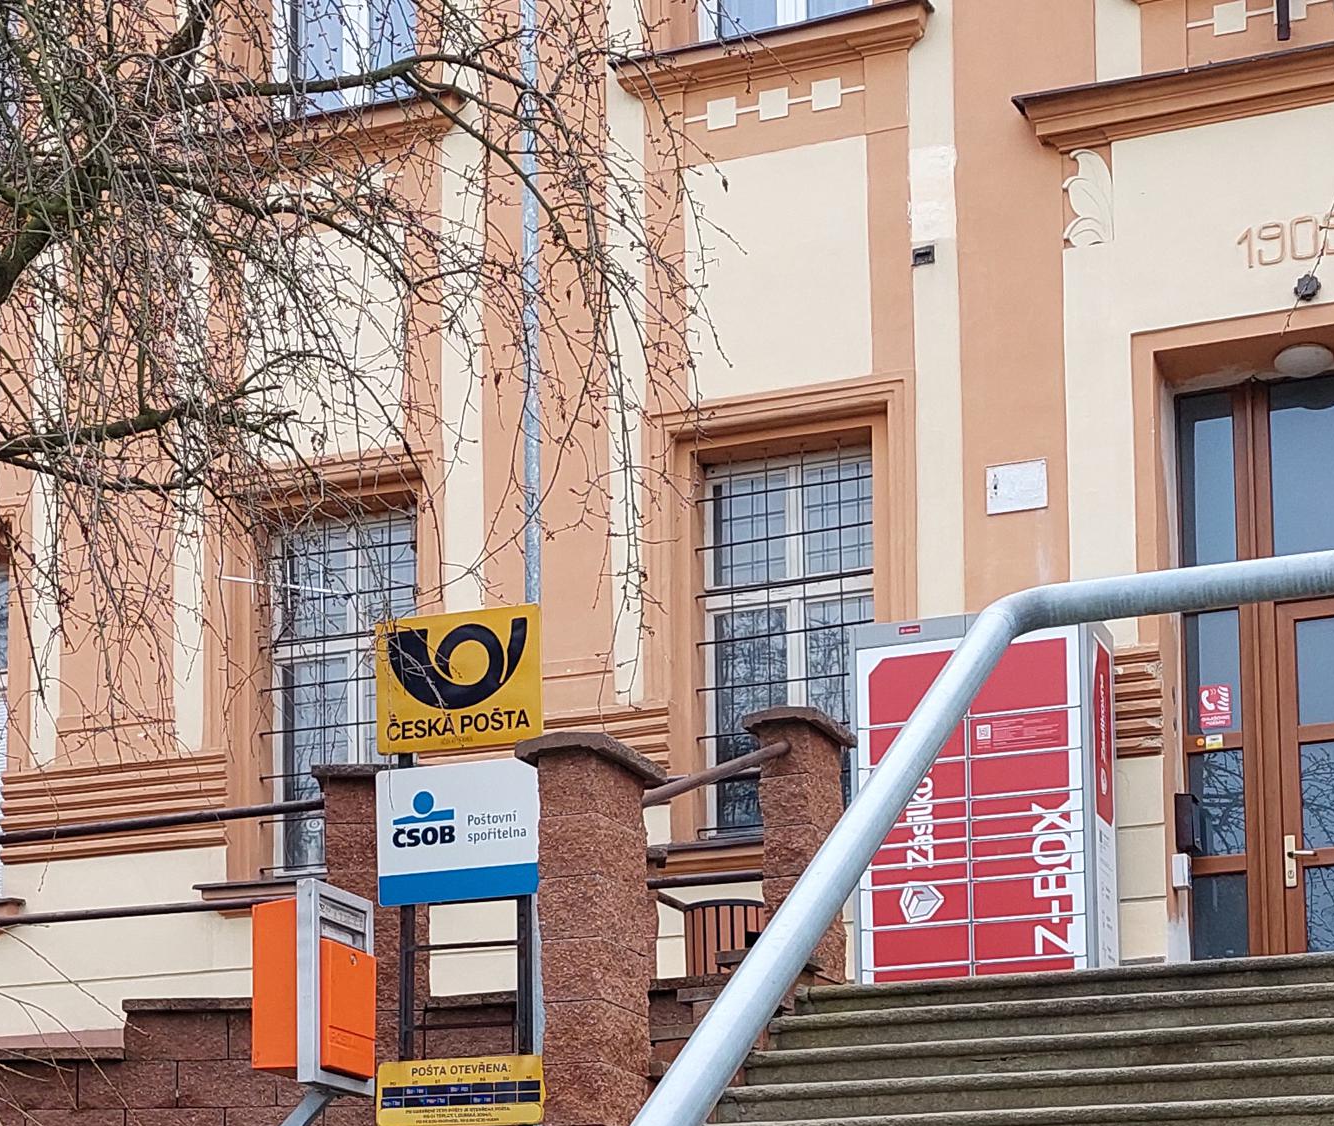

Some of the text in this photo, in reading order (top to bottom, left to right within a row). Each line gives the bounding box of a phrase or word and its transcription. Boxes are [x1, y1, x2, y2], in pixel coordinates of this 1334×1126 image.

[387, 708, 531, 742] ČESKÁ POŠTA
[467, 810, 517, 827] Poštovní
[906, 767, 934, 870] Zásilko
[392, 825, 456, 848] ČSOB
[467, 827, 527, 845] spořitelna
[1031, 799, 1074, 955] Z-BOX
[411, 1061, 512, 1077] POŠTA OTEVŘENA:
